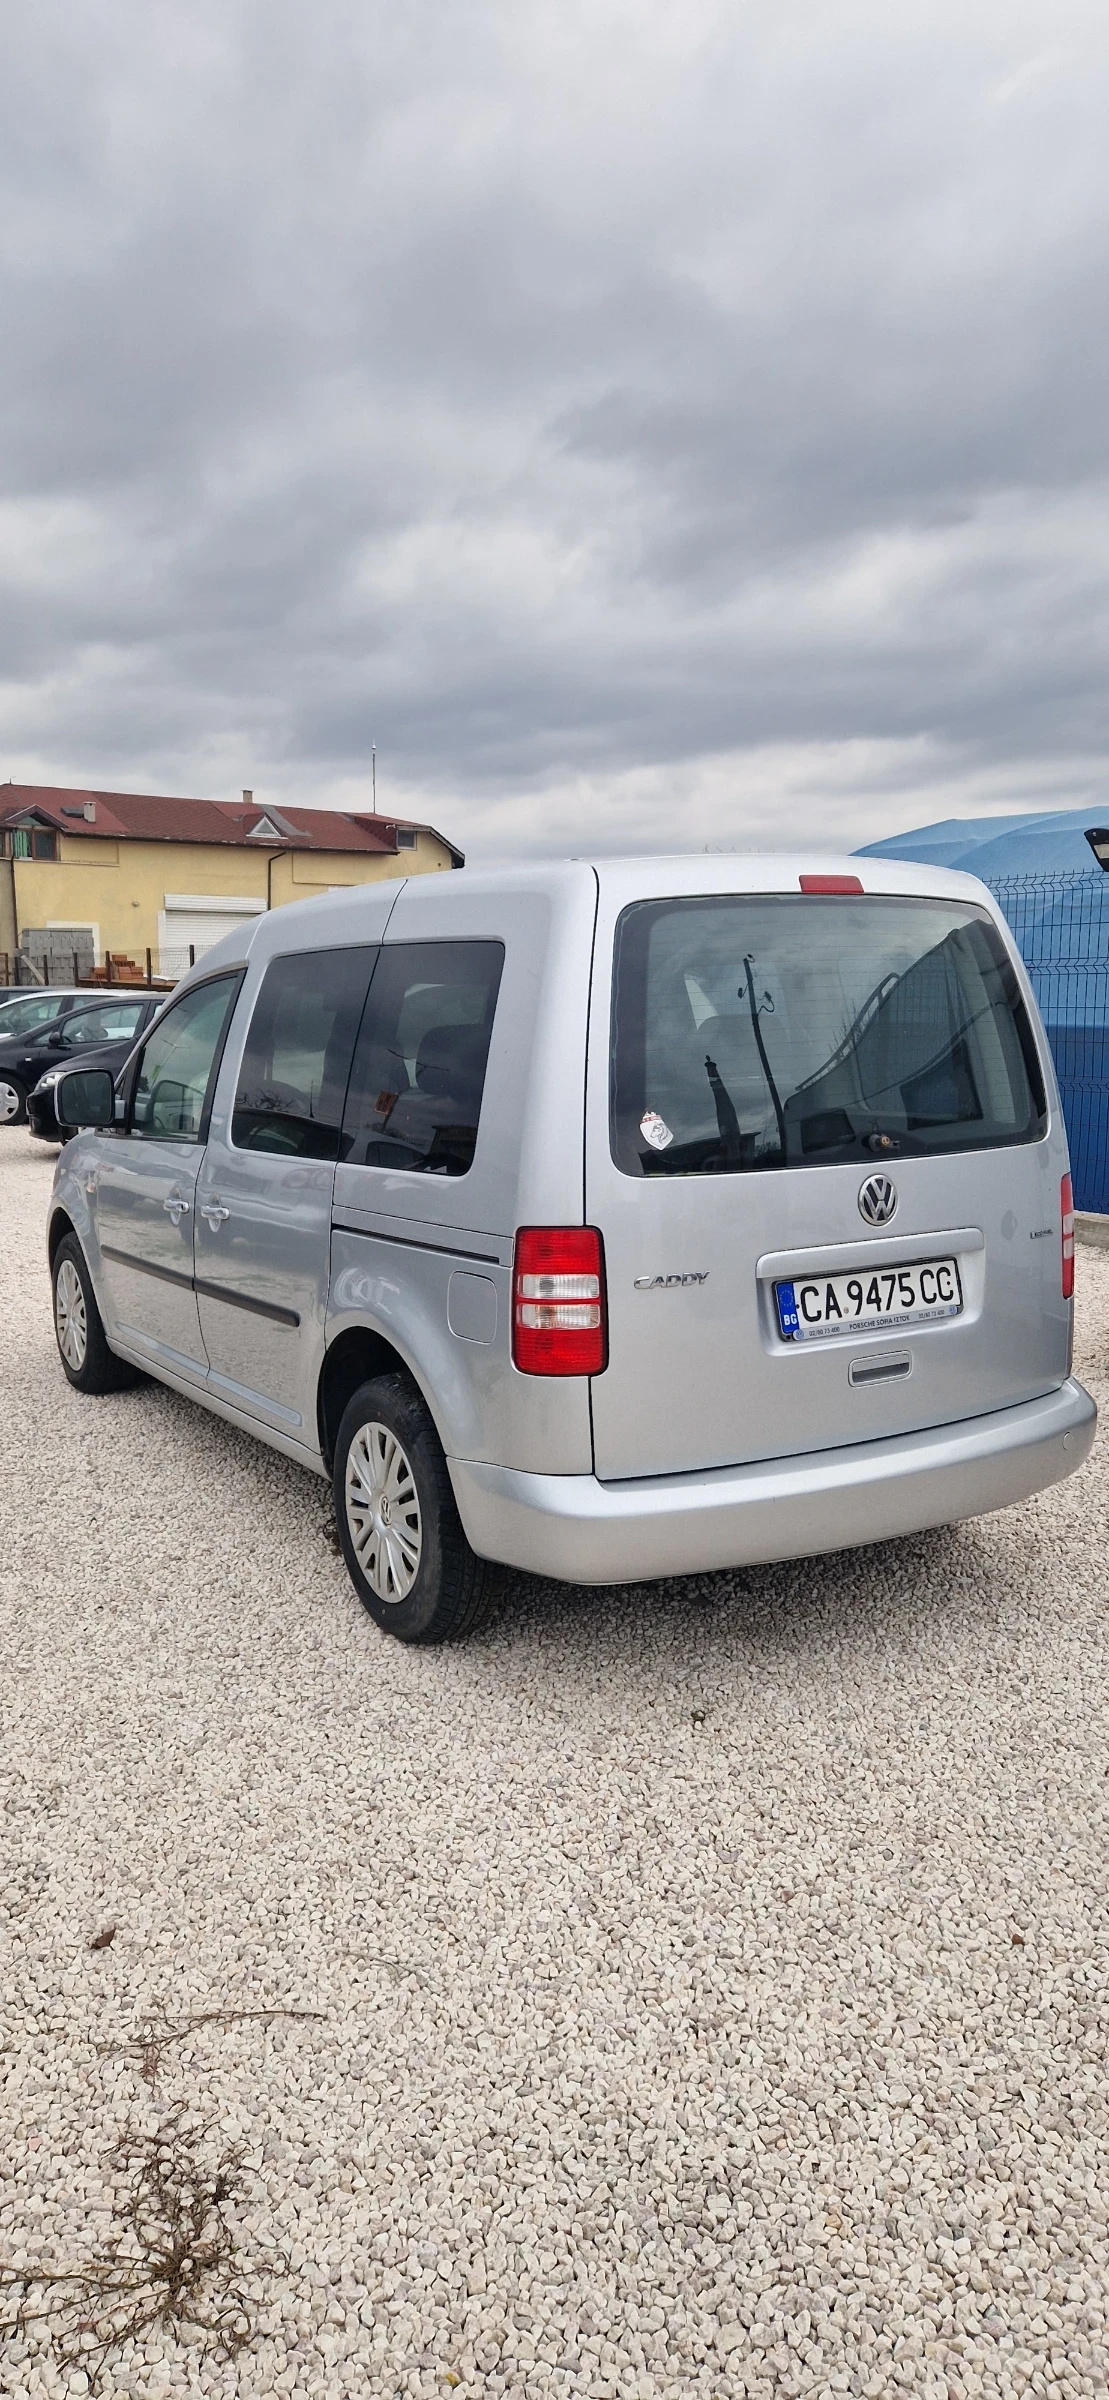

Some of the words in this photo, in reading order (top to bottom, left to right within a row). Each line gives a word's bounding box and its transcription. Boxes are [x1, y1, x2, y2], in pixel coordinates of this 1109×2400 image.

[857, 1174, 898, 1226] VW
[634, 1271, 710, 1289] CADDY
[800, 1283, 842, 1322] CA
[846, 1272, 915, 1315] 9475
[919, 1266, 954, 1304] CC
[784, 1314, 797, 1326] BG
[849, 1320, 876, 1330] PORSCHE
[876, 1317, 893, 1325] SOFIA
